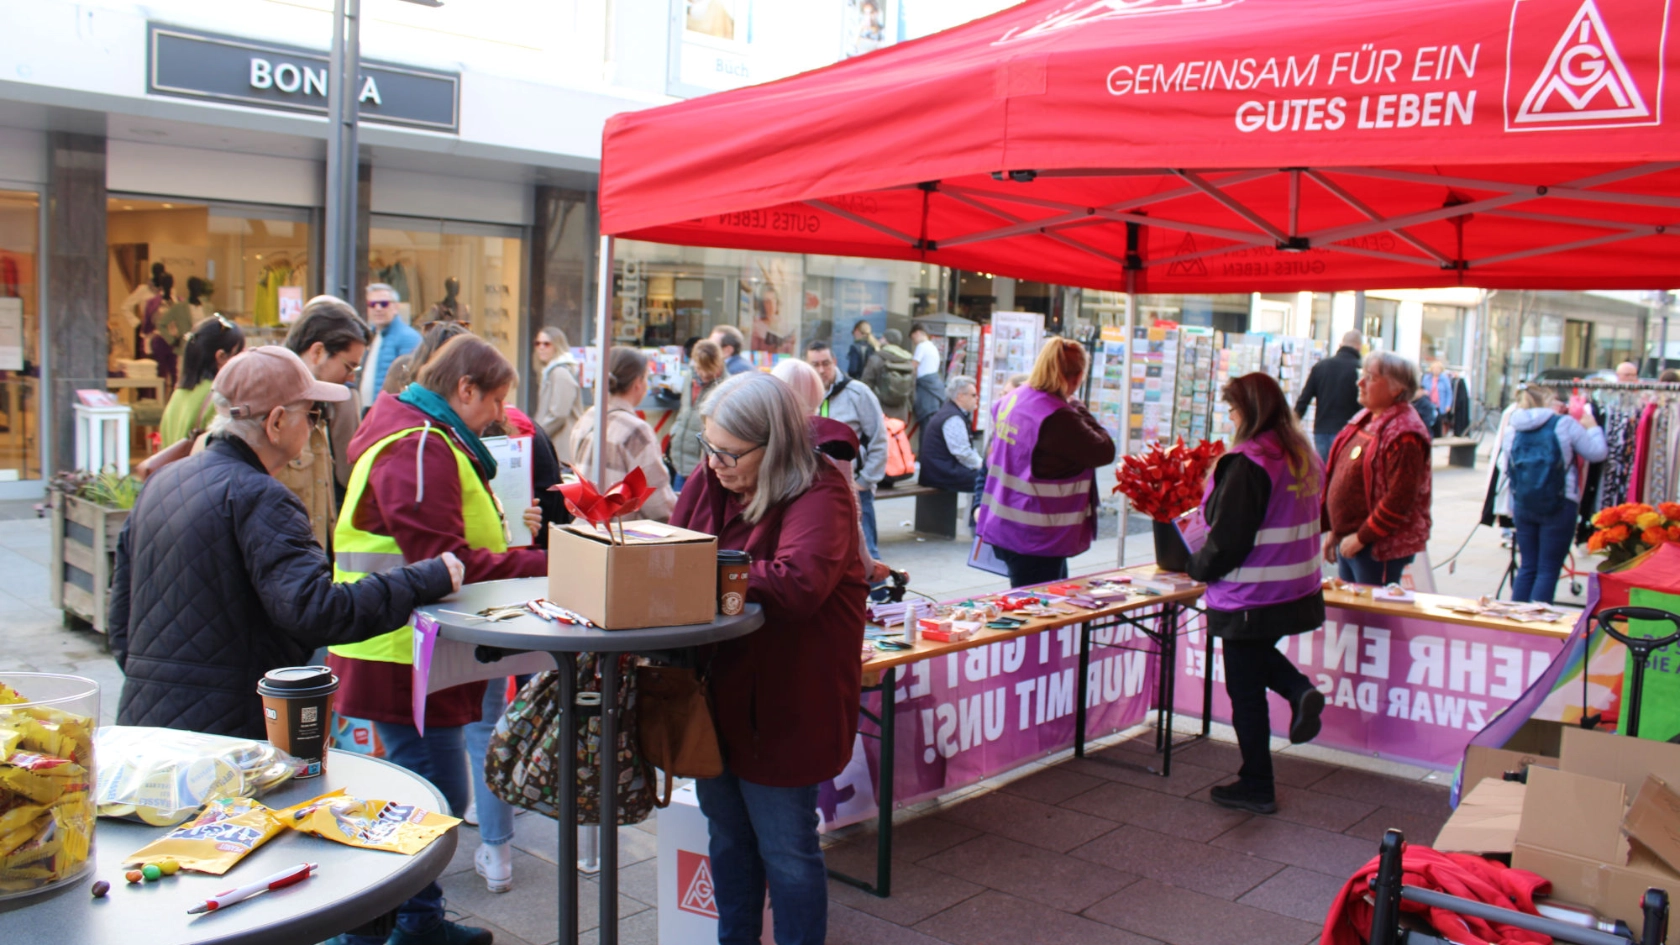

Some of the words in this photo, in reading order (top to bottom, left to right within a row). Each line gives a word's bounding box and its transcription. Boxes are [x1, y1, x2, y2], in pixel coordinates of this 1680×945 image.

[250, 57, 383, 105] BONA
[1106, 54, 1320, 96] GEMEINSAM
[1328, 43, 1403, 86] FÜR
[1411, 43, 1480, 82] EIN
[1234, 96, 1347, 133] GUTES
[1356, 90, 1478, 130] LEBEN
[616, 259, 640, 344] halia
